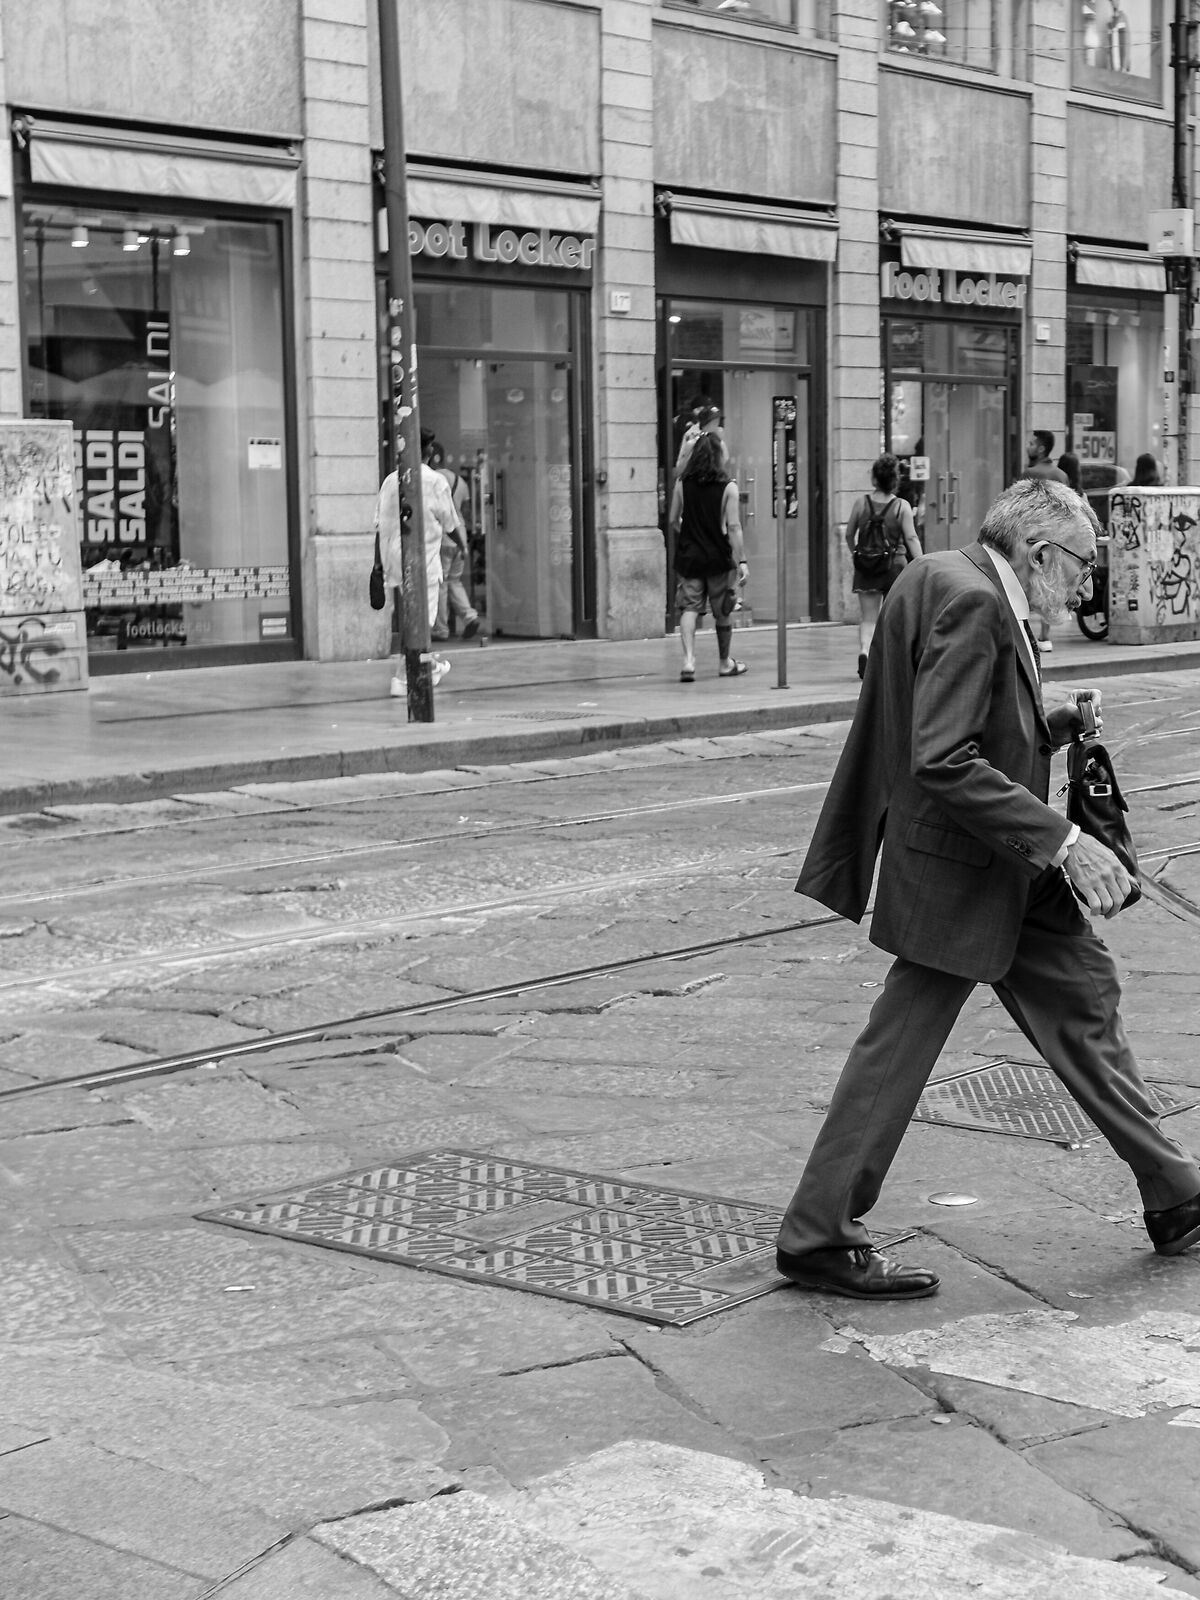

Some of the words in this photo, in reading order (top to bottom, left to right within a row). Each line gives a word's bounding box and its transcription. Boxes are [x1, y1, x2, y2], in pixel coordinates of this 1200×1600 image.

[473, 221, 598, 269] Locker
[881, 262, 942, 302] Foot
[943, 269, 1027, 308] Locker
[1075, 435, 1115, 459] -50%
[86, 430, 115, 543] SALDI
[118, 431, 146, 543] SALDI
